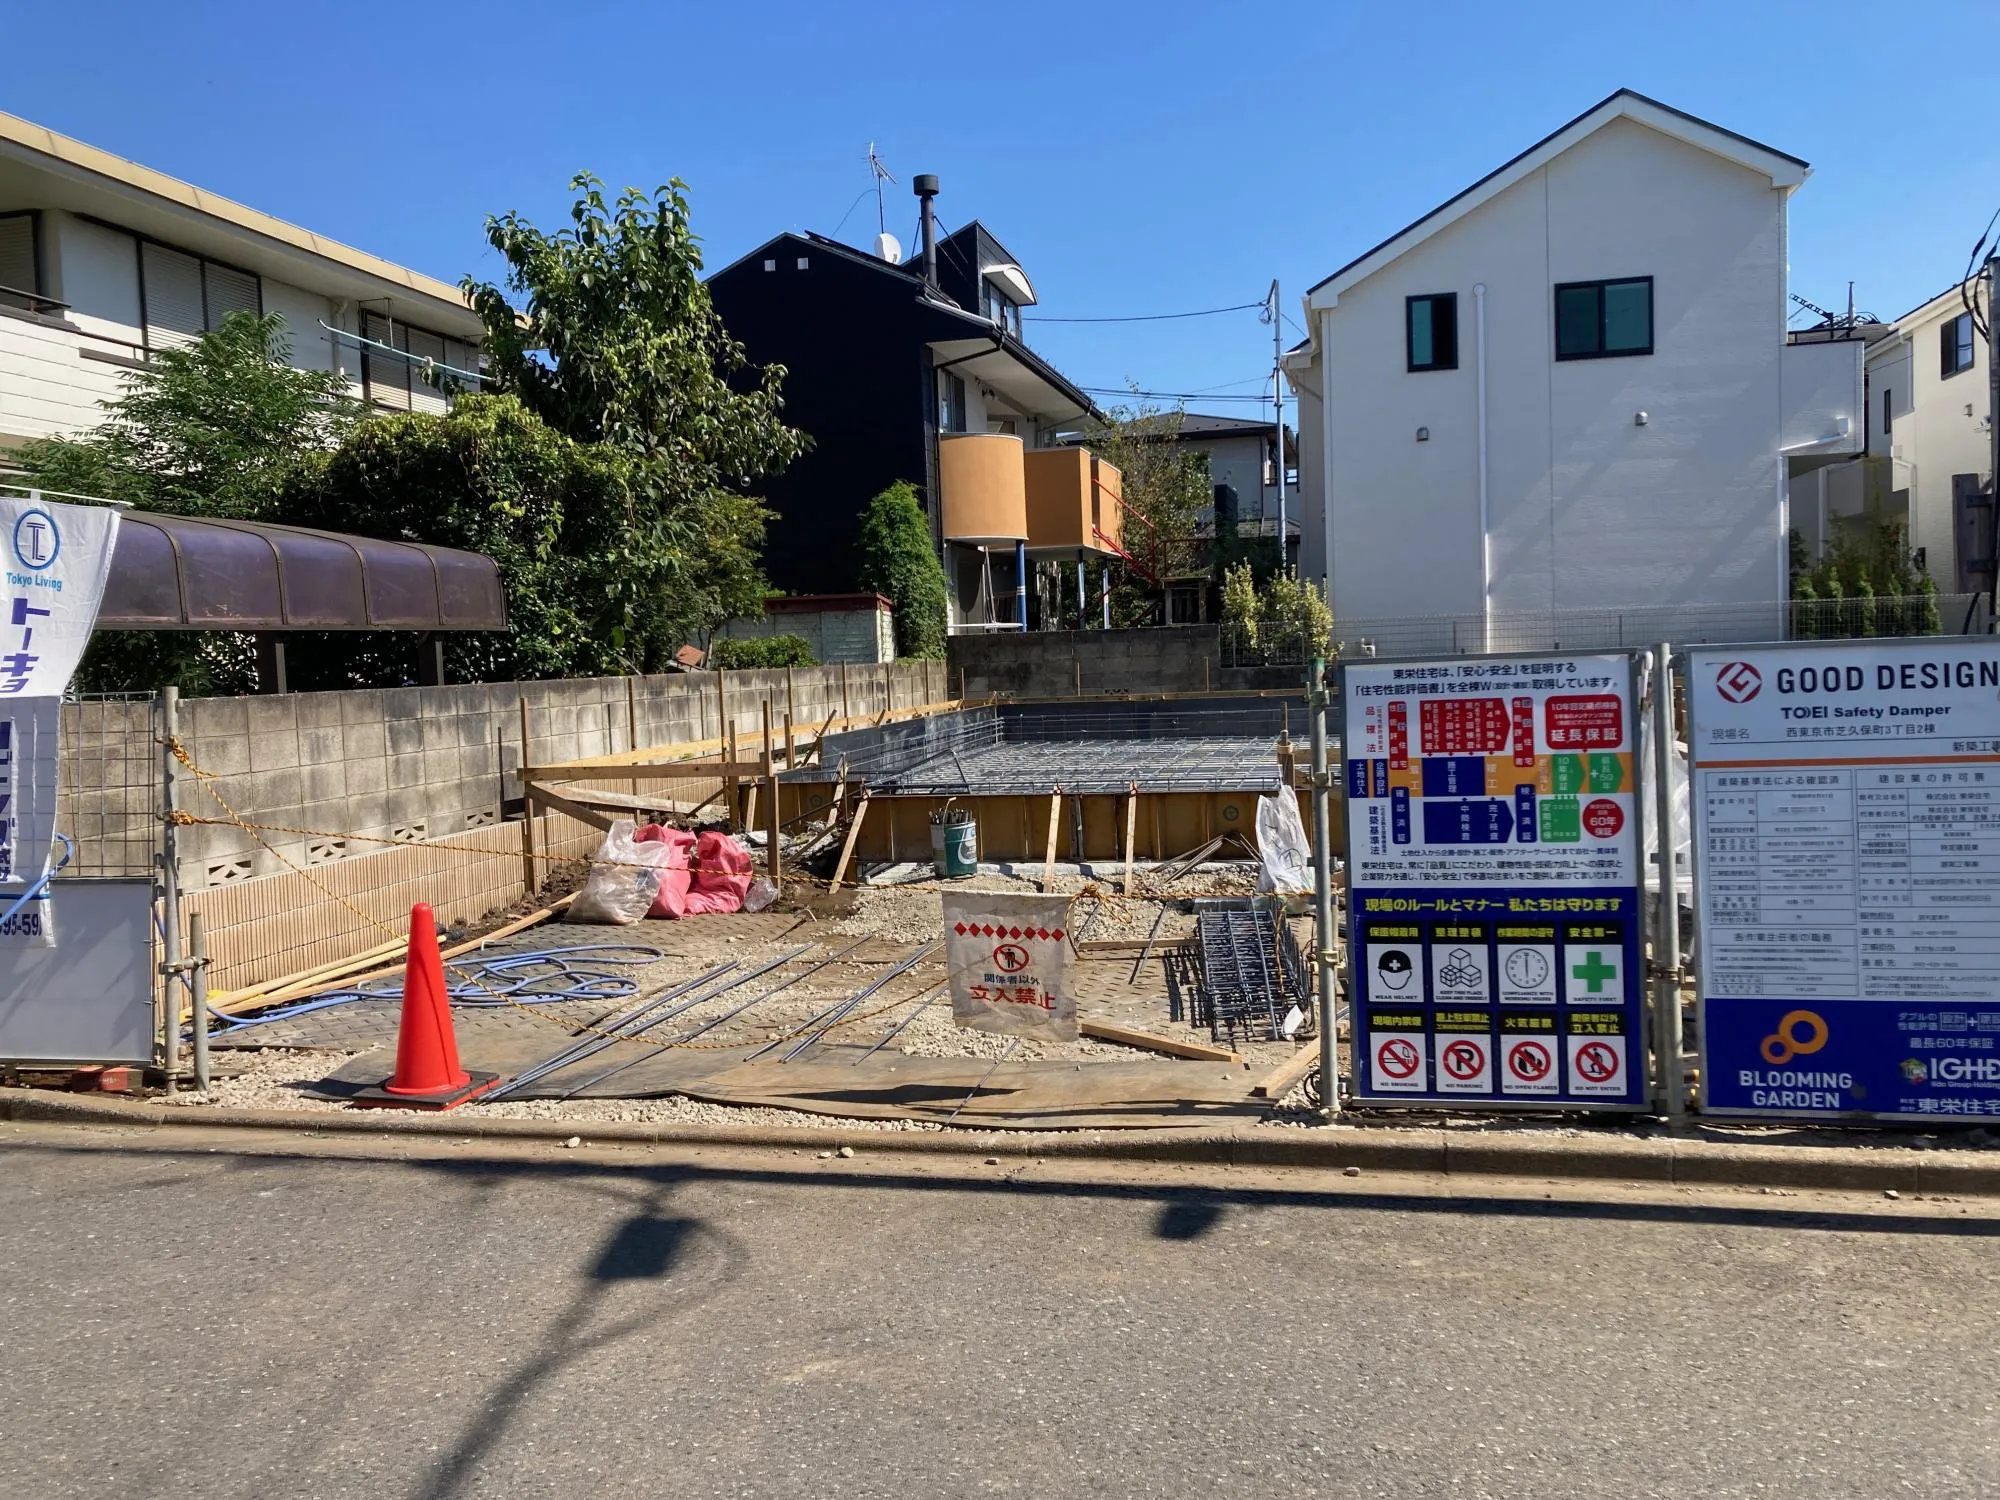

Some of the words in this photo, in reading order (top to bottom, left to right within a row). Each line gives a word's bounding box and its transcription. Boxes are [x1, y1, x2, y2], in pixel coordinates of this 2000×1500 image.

[6, 572, 33, 588] Tokyo
[34, 574, 63, 592] Living
[1777, 666, 1865, 694] GOOD
[1877, 661, 1999, 690] DESIGN
[1834, 706, 1884, 719] Safety
[1889, 705, 1952, 718] Damper
[1551, 727, 1618, 742] 延長保証
[1712, 728, 1750, 739] 現場名
[1590, 817, 1617, 826] 60年
[1365, 898, 1505, 912] 現場のルールとマナー
[1508, 897, 1623, 912] 私たちは守ります
[983, 972, 1041, 986] 関係者以外
[969, 984, 1058, 1011] 立入禁止
[1739, 1069, 1853, 1089] BLOOMING
[1752, 1089, 1840, 1109] GARDEN
